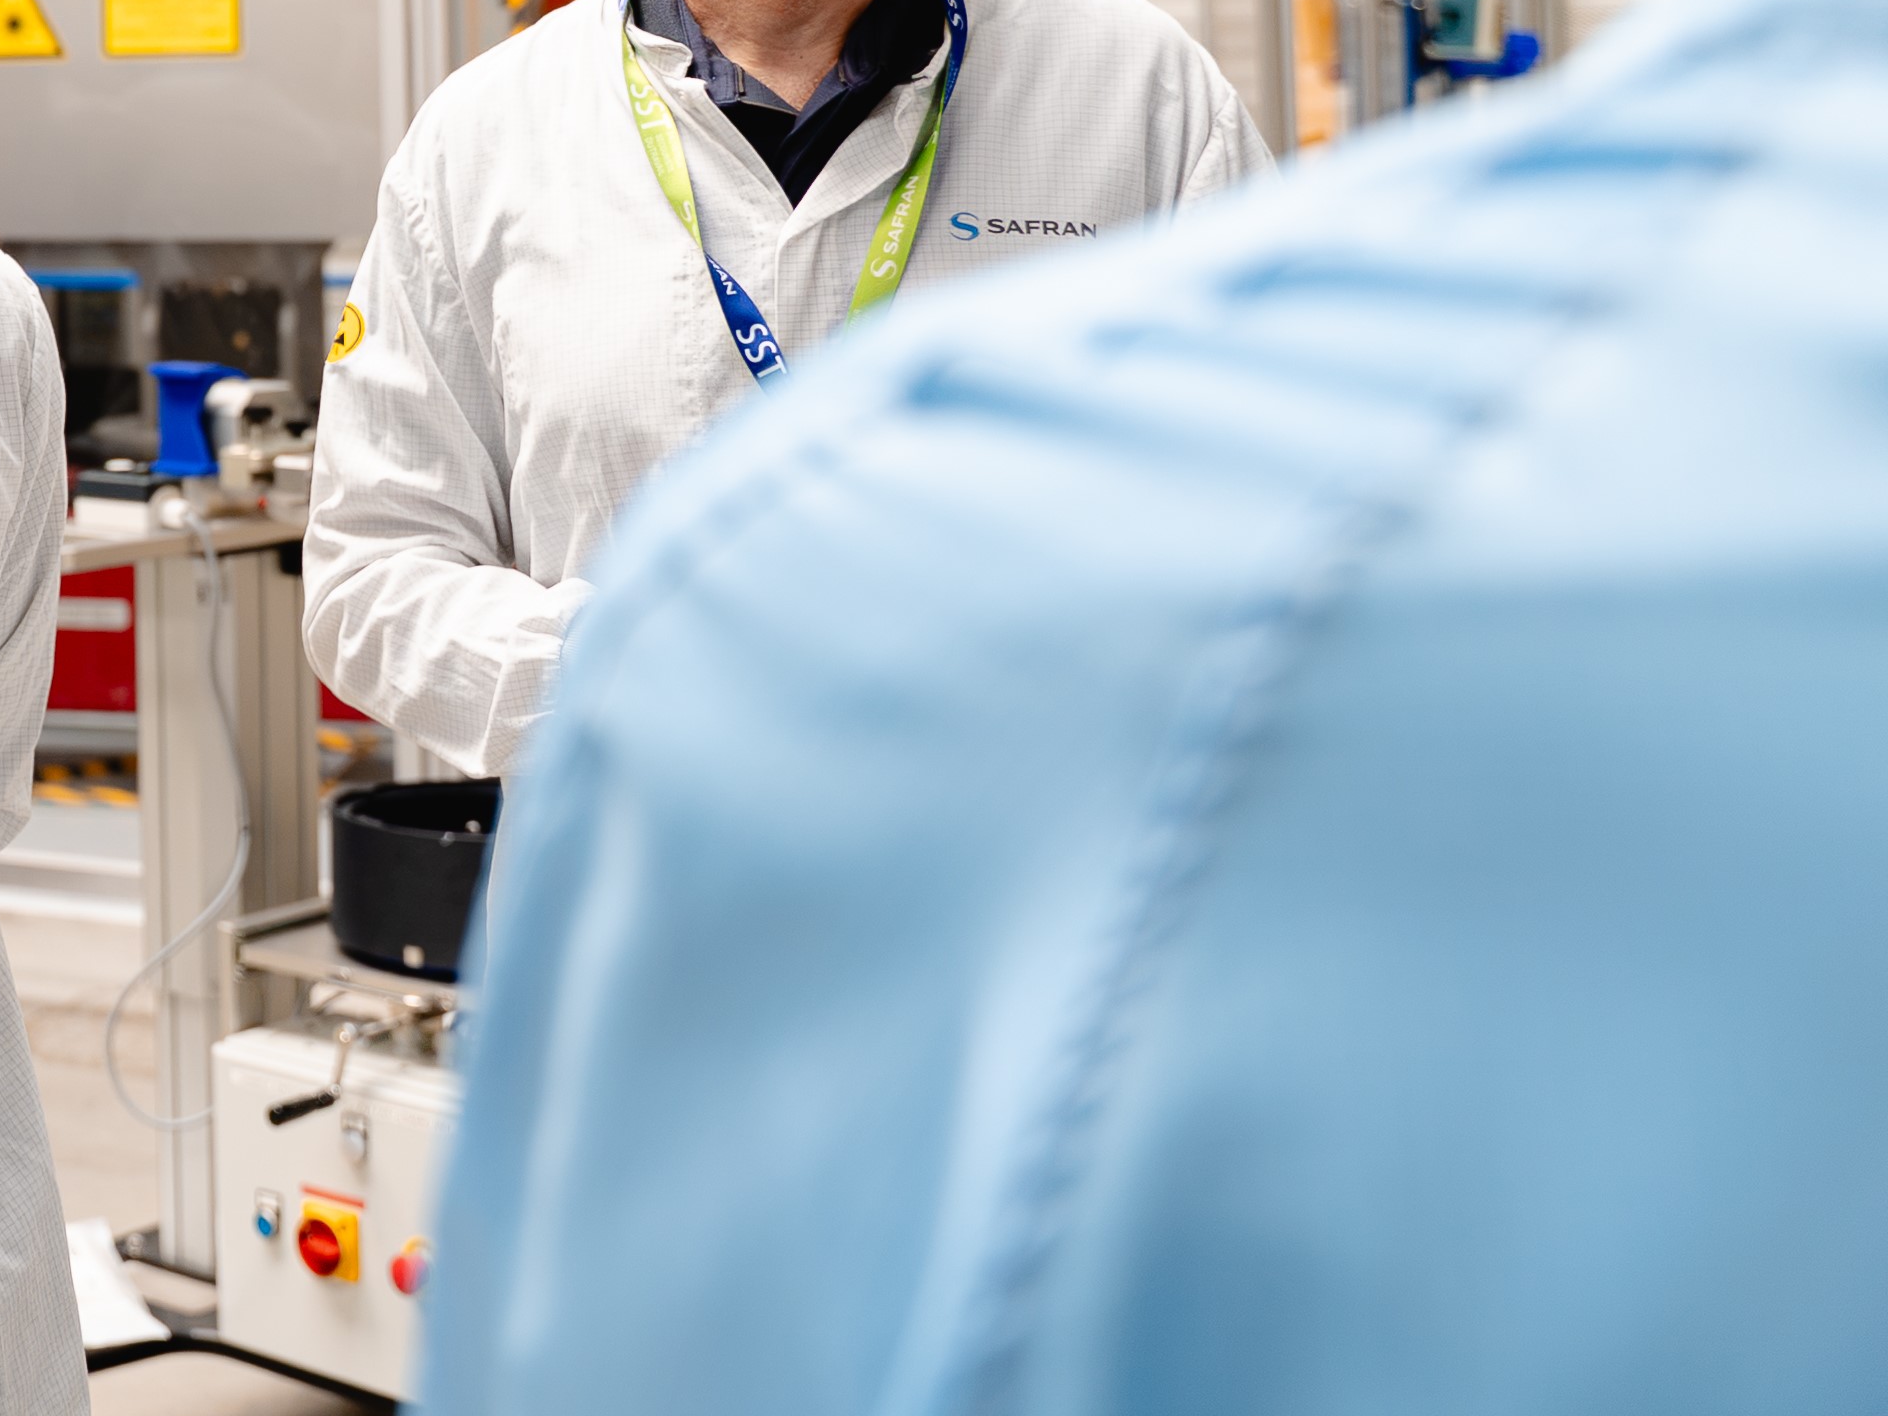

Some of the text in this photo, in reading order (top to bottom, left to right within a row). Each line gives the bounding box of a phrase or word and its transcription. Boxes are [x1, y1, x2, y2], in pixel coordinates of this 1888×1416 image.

[630, 83, 673, 130] SST
[883, 175, 919, 255] SAFRAN
[987, 218, 1097, 239] SAFRAN
[735, 323, 788, 379] SST
